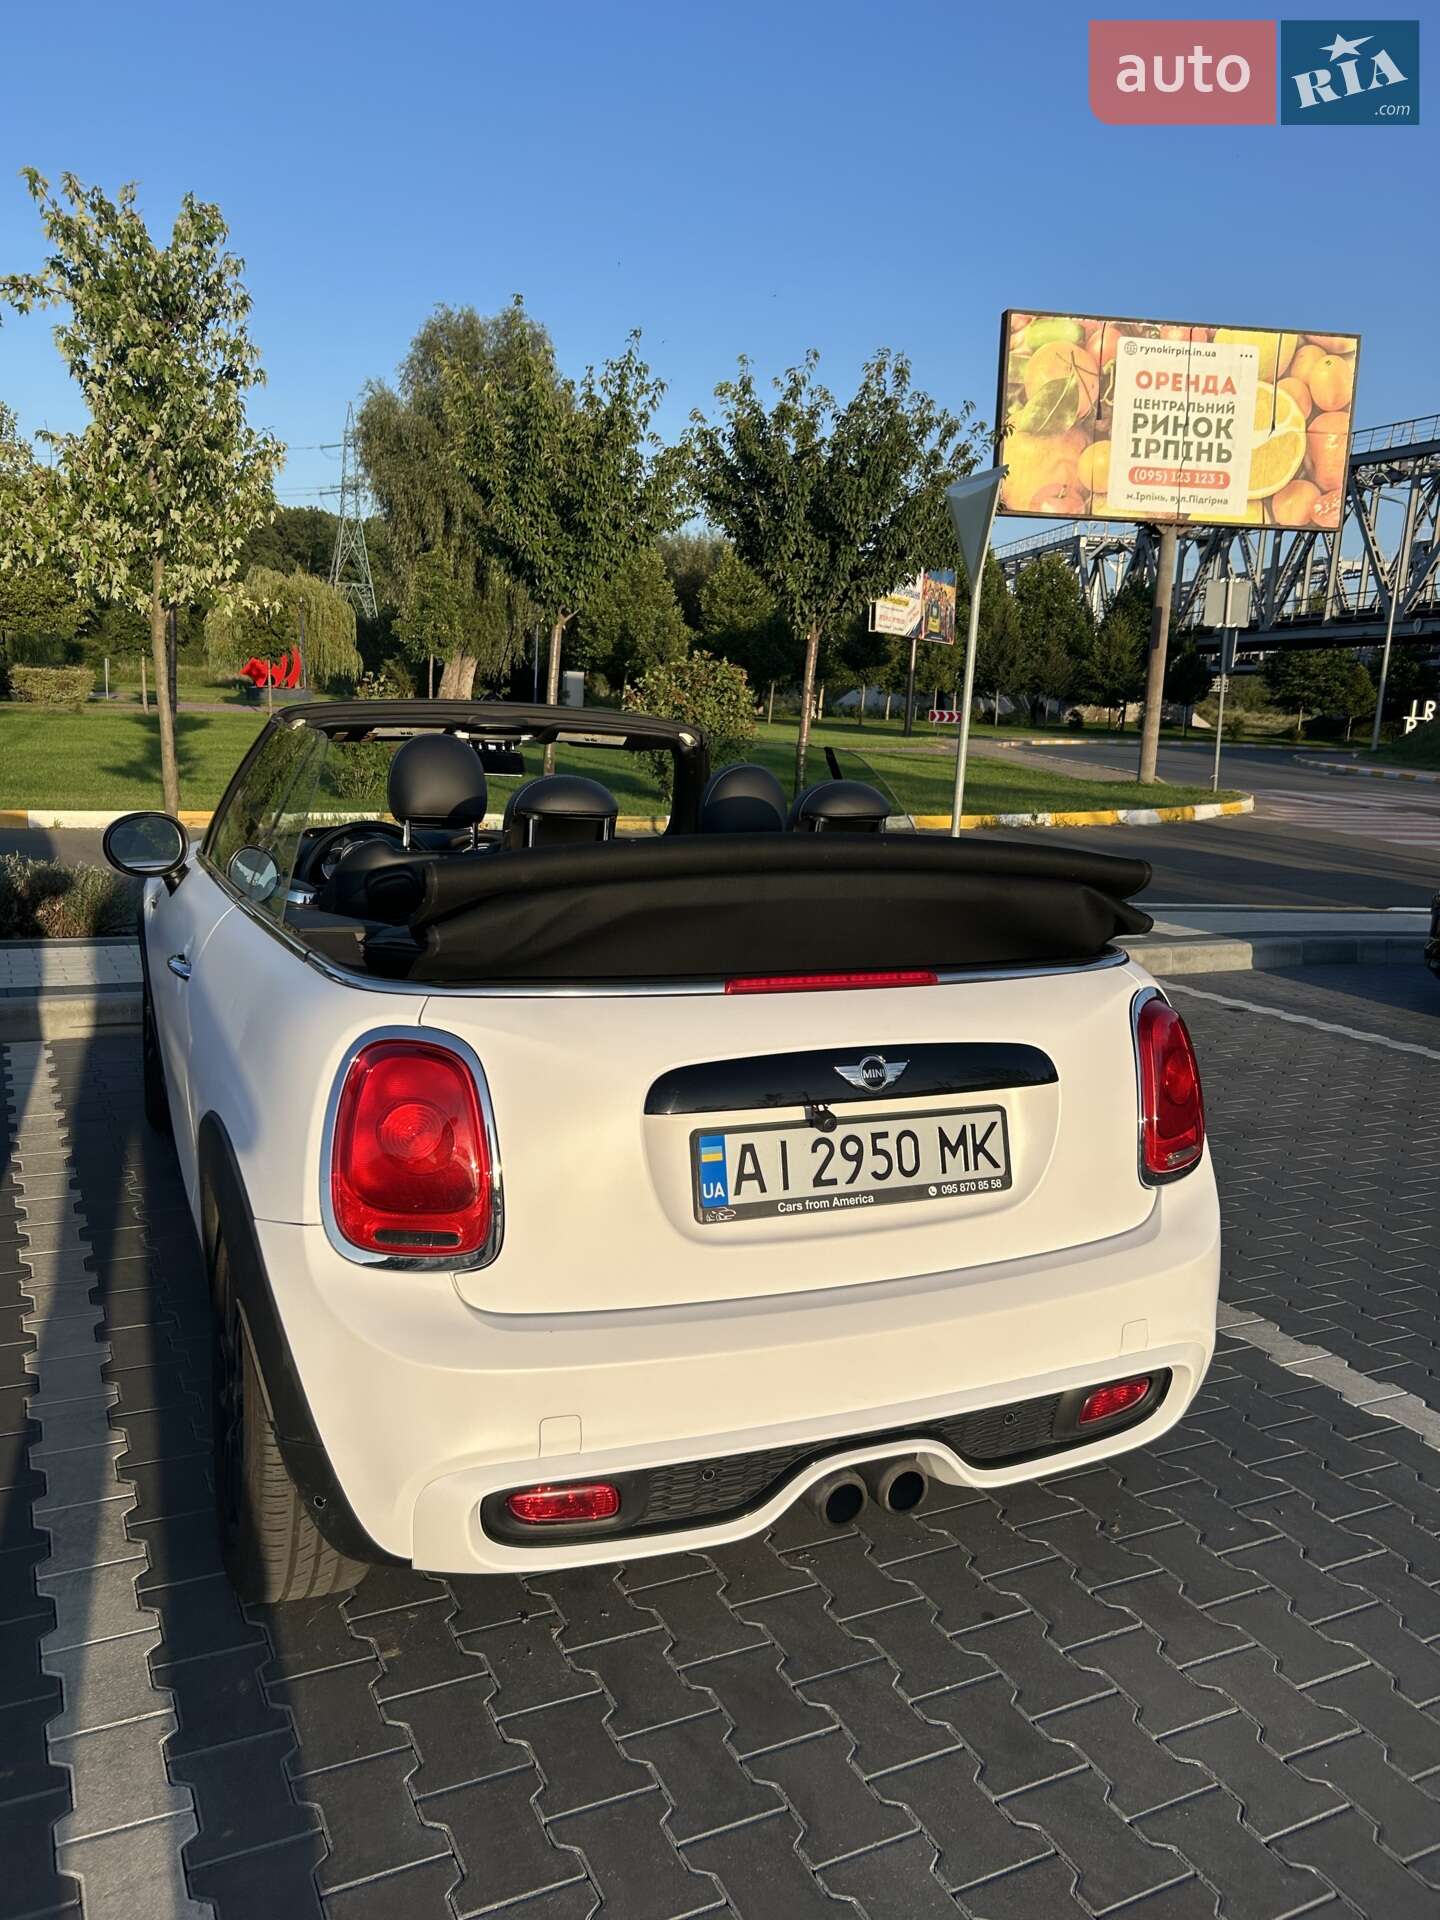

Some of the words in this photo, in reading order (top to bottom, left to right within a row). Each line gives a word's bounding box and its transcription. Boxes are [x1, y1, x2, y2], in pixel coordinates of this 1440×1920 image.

[1135, 370, 1237, 396] ОРЕНДА
[1133, 398, 1235, 414] ЦЕНТРАЛЬНИЙ
[1132, 413, 1234, 440] РИНОК
[1130, 438, 1233, 463] ІРПІНЬ
[1134, 468, 1168, 484] (095)
[1172, 471, 1191, 484] 123
[1195, 472, 1216, 485] 123
[862, 1069, 885, 1079] MINI
[733, 1140, 790, 1196] AI
[810, 1129, 921, 1188] 2950
[937, 1121, 1001, 1175] MK
[702, 1182, 725, 1199] UA
[941, 1184, 958, 1195] 095
[959, 1182, 976, 1193] 870
[978, 1180, 989, 1190] 85
[990, 1179, 1002, 1189] 58
[777, 1202, 803, 1213] Cars
[805, 1198, 830, 1211] from
[832, 1194, 874, 1207] America
